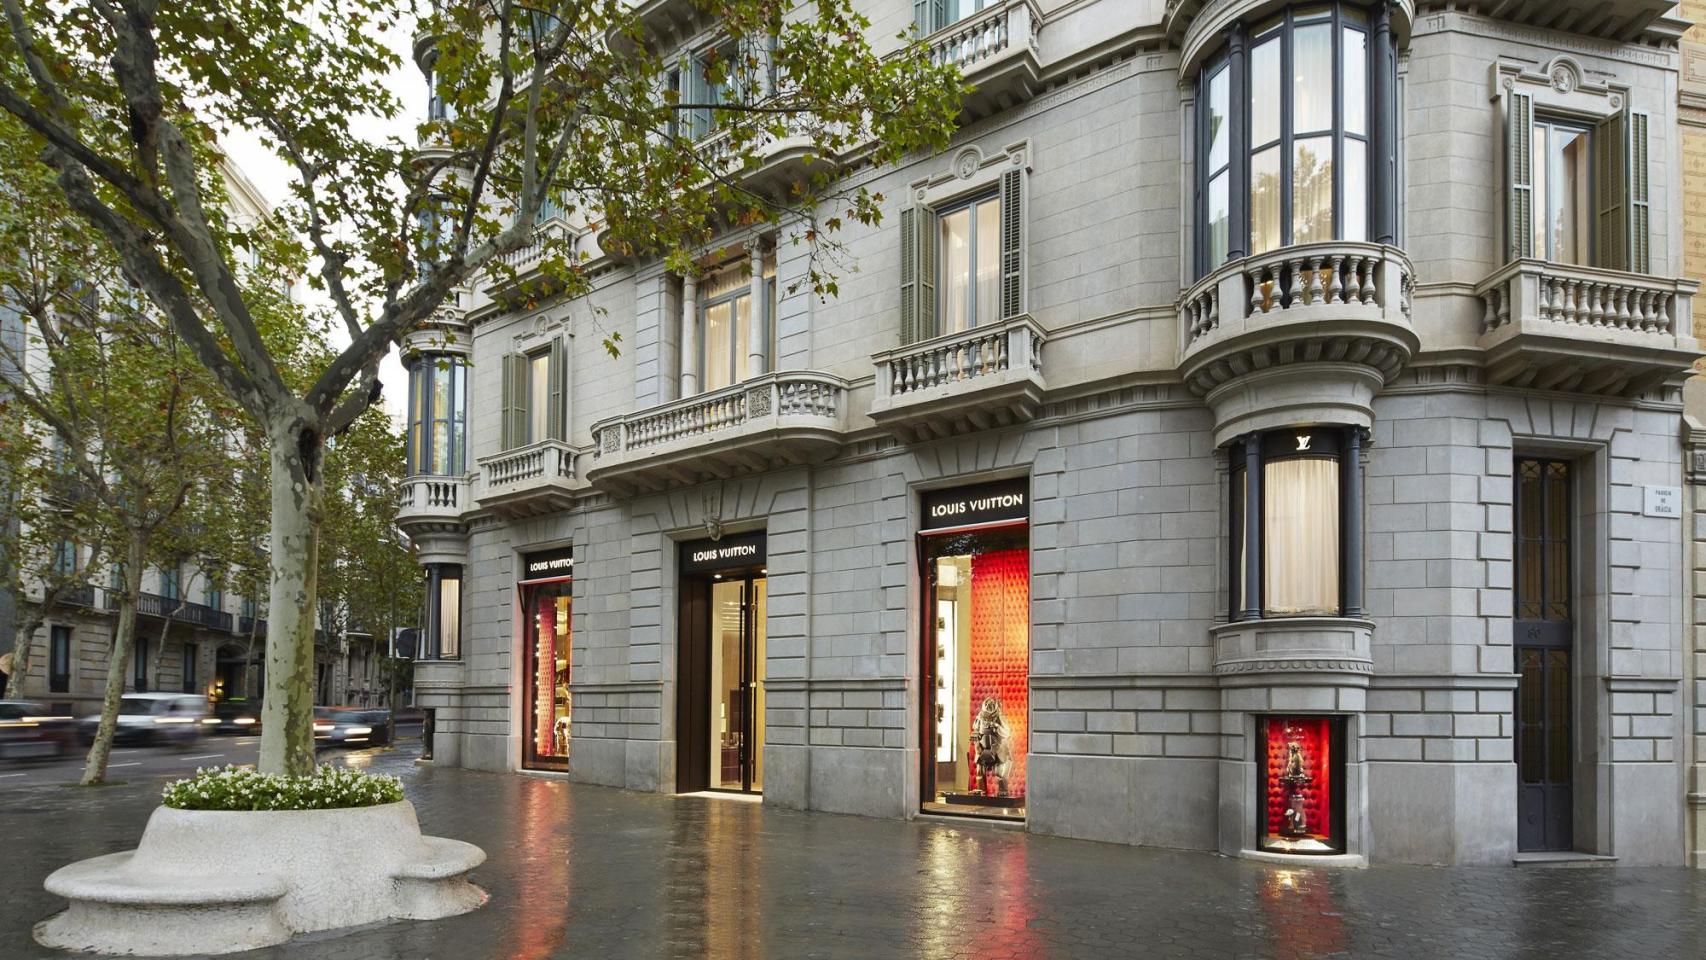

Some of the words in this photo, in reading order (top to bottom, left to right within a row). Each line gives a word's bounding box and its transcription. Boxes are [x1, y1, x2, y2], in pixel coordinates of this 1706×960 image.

[932, 502, 966, 517] LOUIS
[969, 494, 1023, 511] VUITTON
[693, 550, 717, 561] LOUIS
[719, 545, 755, 558] VUITTON
[530, 561, 548, 571] LOUIS
